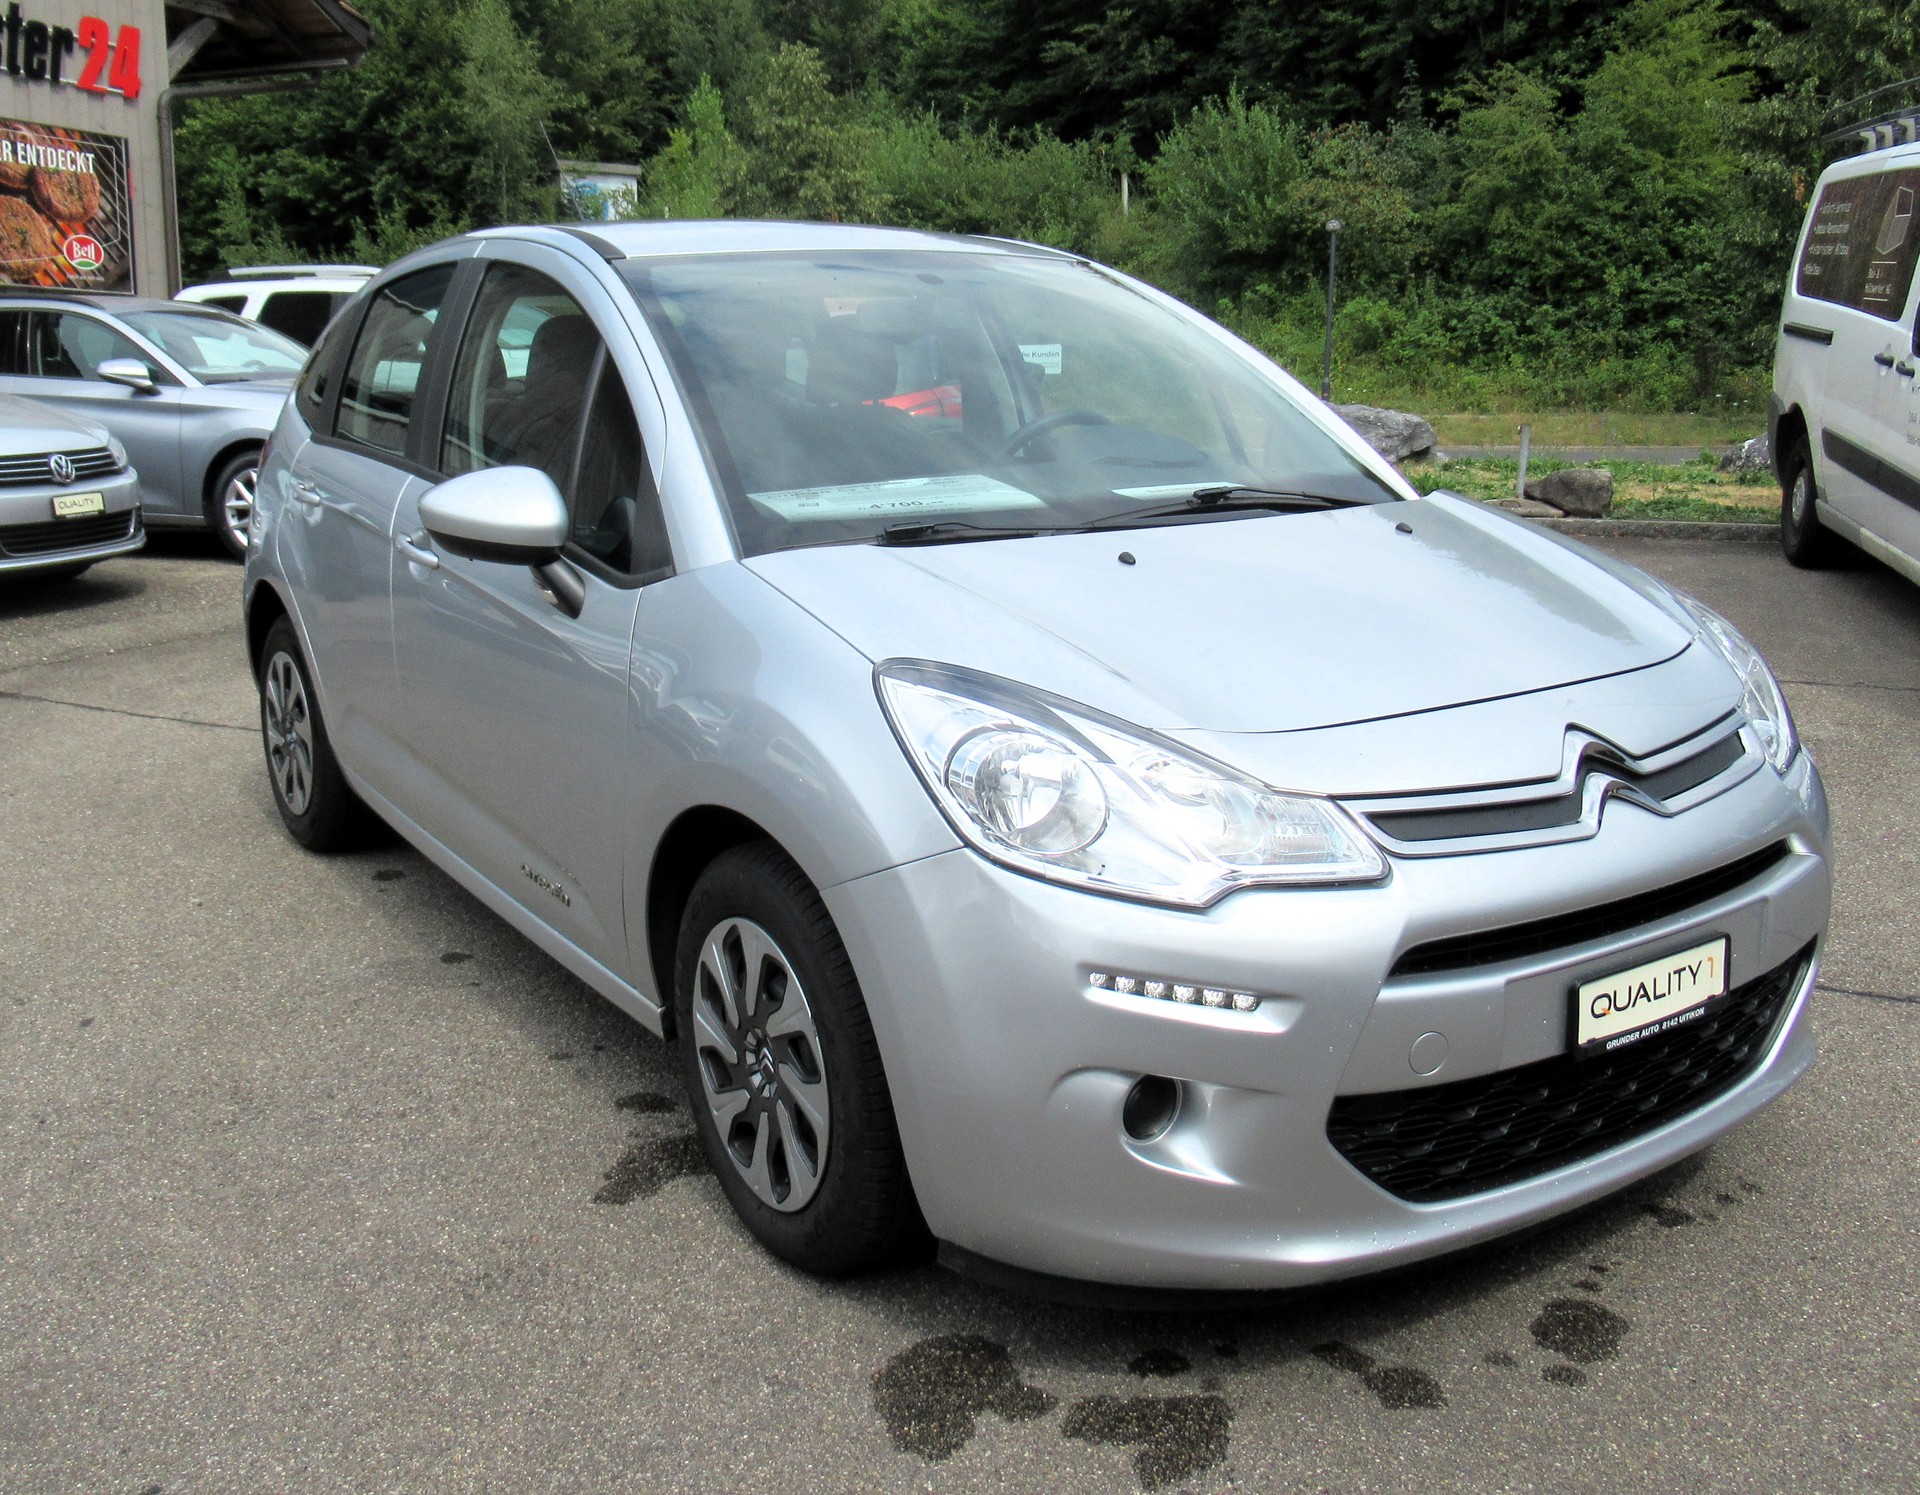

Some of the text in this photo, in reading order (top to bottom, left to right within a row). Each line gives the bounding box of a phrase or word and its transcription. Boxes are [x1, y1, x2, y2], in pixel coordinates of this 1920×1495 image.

[0, 2, 141, 98] ter24
[17, 142, 94, 174] ENTDECKT
[72, 241, 96, 261] Bell
[1605, 1031, 1640, 1050] GRUNDER
[1640, 1024, 1660, 1038] AUTO
[1662, 1017, 1678, 1030] 8142
